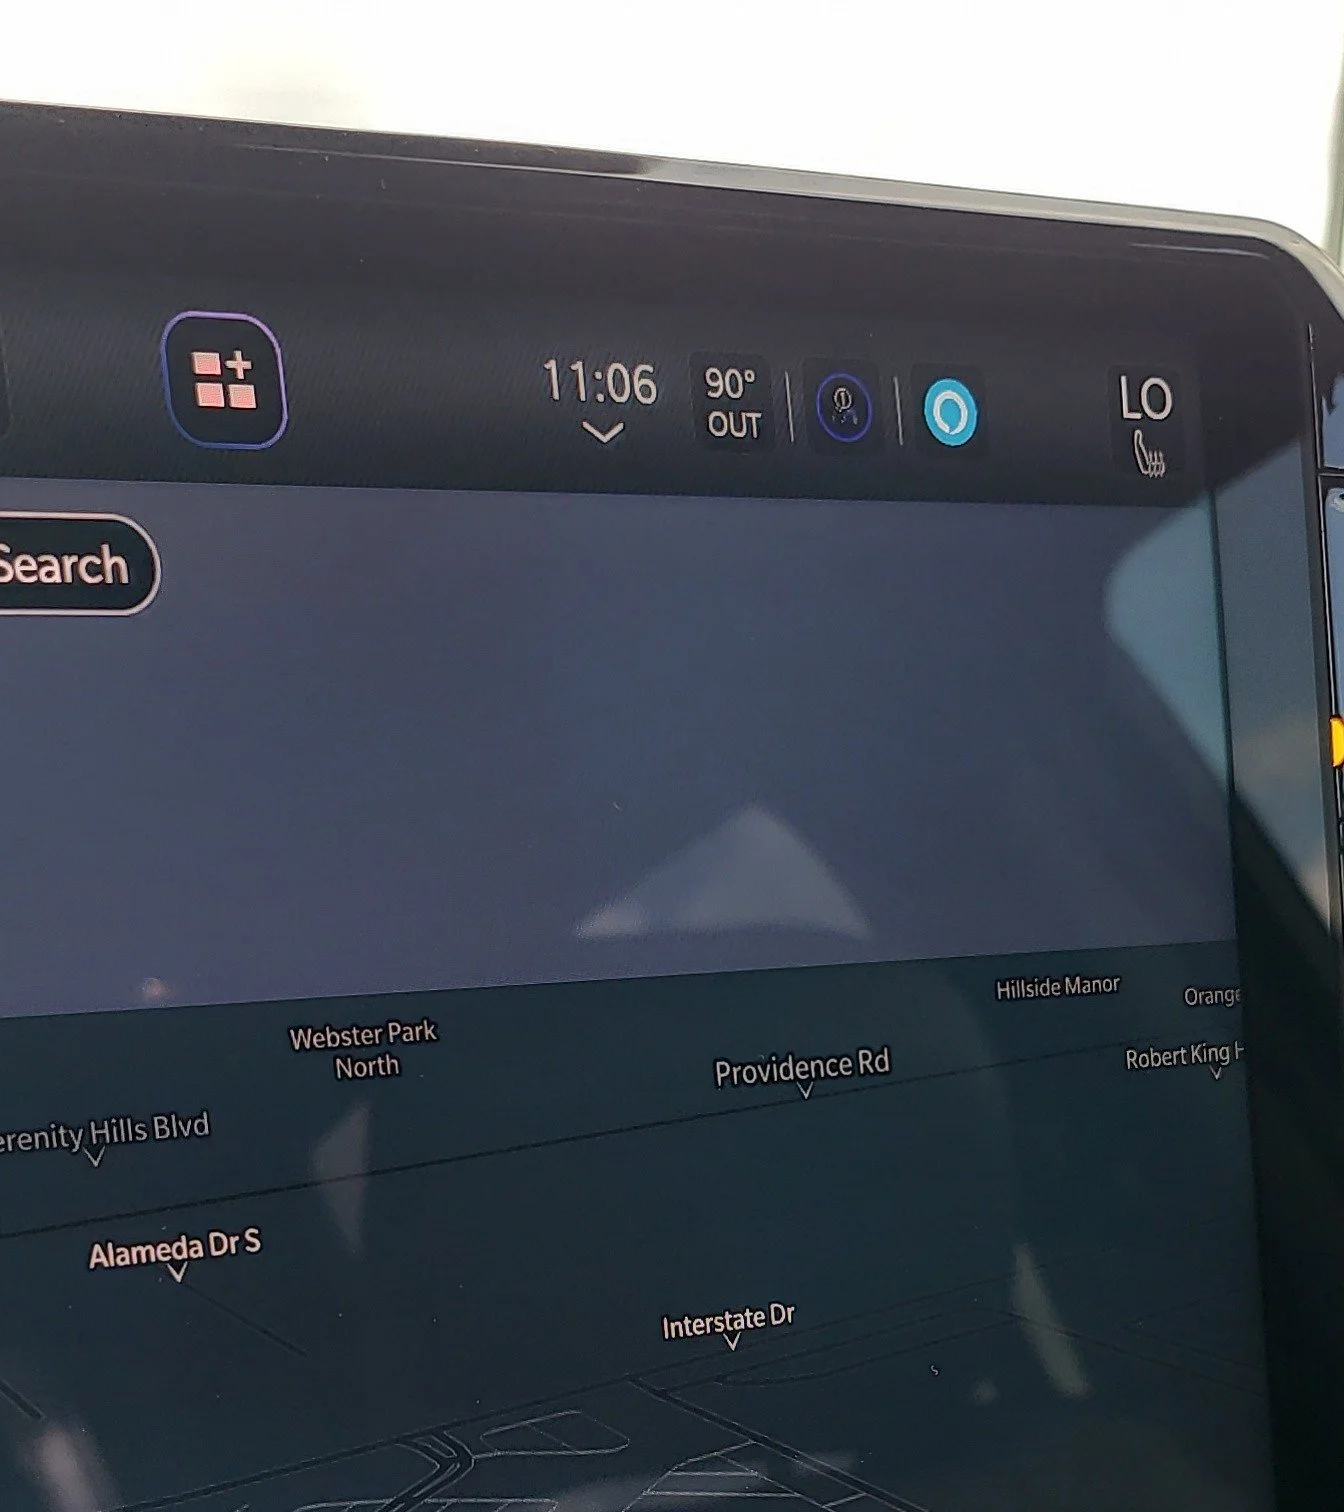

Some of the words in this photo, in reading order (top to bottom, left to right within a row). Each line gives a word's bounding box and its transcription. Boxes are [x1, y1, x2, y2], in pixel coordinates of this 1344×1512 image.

[542, 358, 658, 407] 11:06
[703, 366, 756, 399] 90°
[1118, 374, 1174, 421] LO
[706, 411, 763, 440] OUT
[995, 977, 1062, 1001] Hillside
[1063, 974, 1122, 997] Manor
[288, 1020, 384, 1052] Webster
[387, 1017, 440, 1044] Park
[334, 1053, 402, 1081] North
[714, 1053, 855, 1089] Providence
[856, 1047, 892, 1076] Rd
[1125, 1046, 1188, 1070] Robert
[1189, 1042, 1231, 1067] King
[89, 1117, 149, 1147] Hills
[153, 1111, 211, 1140] Blvd
[88, 1237, 205, 1270] Alameda
[207, 1231, 242, 1259] Dr
[243, 1227, 262, 1253] S
[661, 1307, 767, 1341] Interstate
[768, 1303, 796, 1327] Dr
